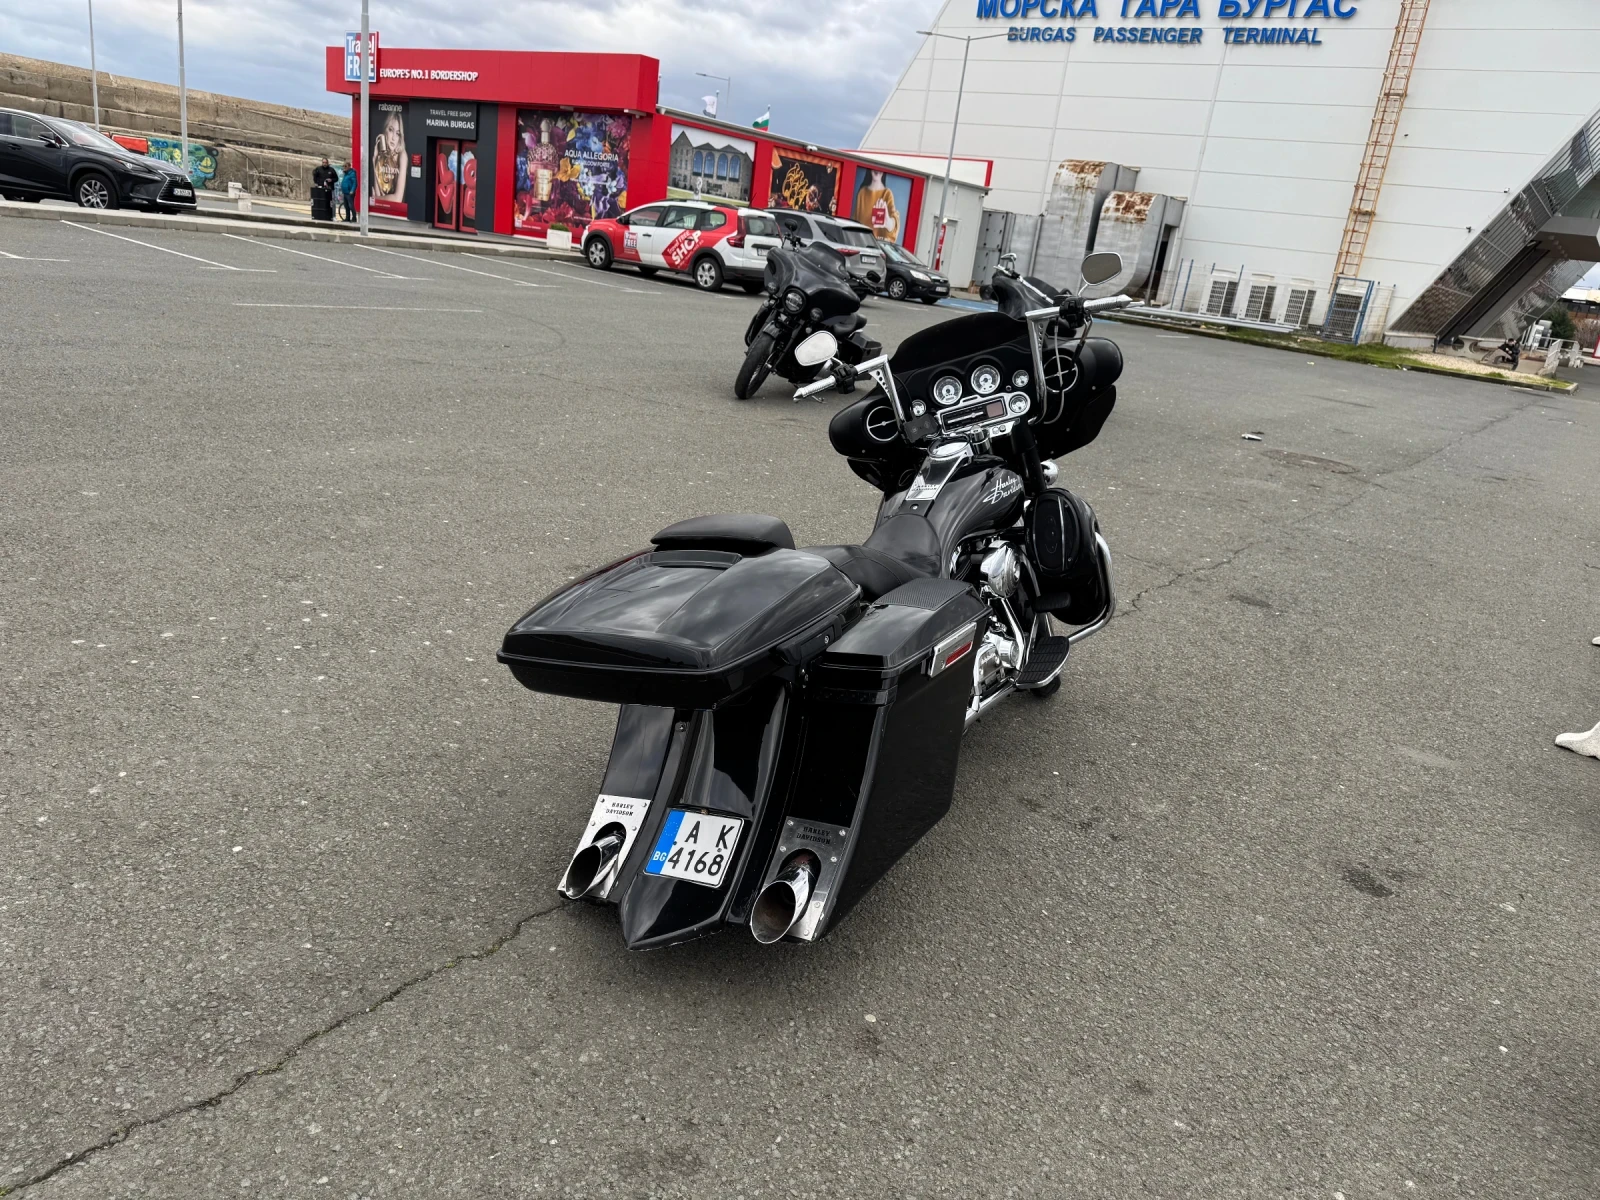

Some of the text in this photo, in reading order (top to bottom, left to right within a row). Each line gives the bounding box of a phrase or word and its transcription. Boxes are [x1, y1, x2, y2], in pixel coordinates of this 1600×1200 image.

[976, 0, 1098, 18] МОРСКА
[1007, 26, 1322, 45] BURGAS PASSENGER TERMINAL
[347, 35, 375, 54] Trael
[347, 55, 375, 77] FRE
[380, 68, 410, 79] EUROPE'S
[430, 70, 478, 81] BORDERSHOP
[378, 102, 403, 112] rabanne
[426, 118, 475, 129] MARINA BURGAS
[564, 149, 619, 161] AQUA ALLEGORIA
[625, 239, 637, 248] FREE
[672, 230, 702, 265] SHOP
[991, 476, 1018, 491] Harley
[612, 802, 634, 810] HARLEY
[684, 820, 735, 850] A K
[803, 826, 831, 837] HARLEY
[796, 832, 831, 845] DAVIDSON
[653, 850, 667, 862] BG
[668, 847, 724, 876] 4168
